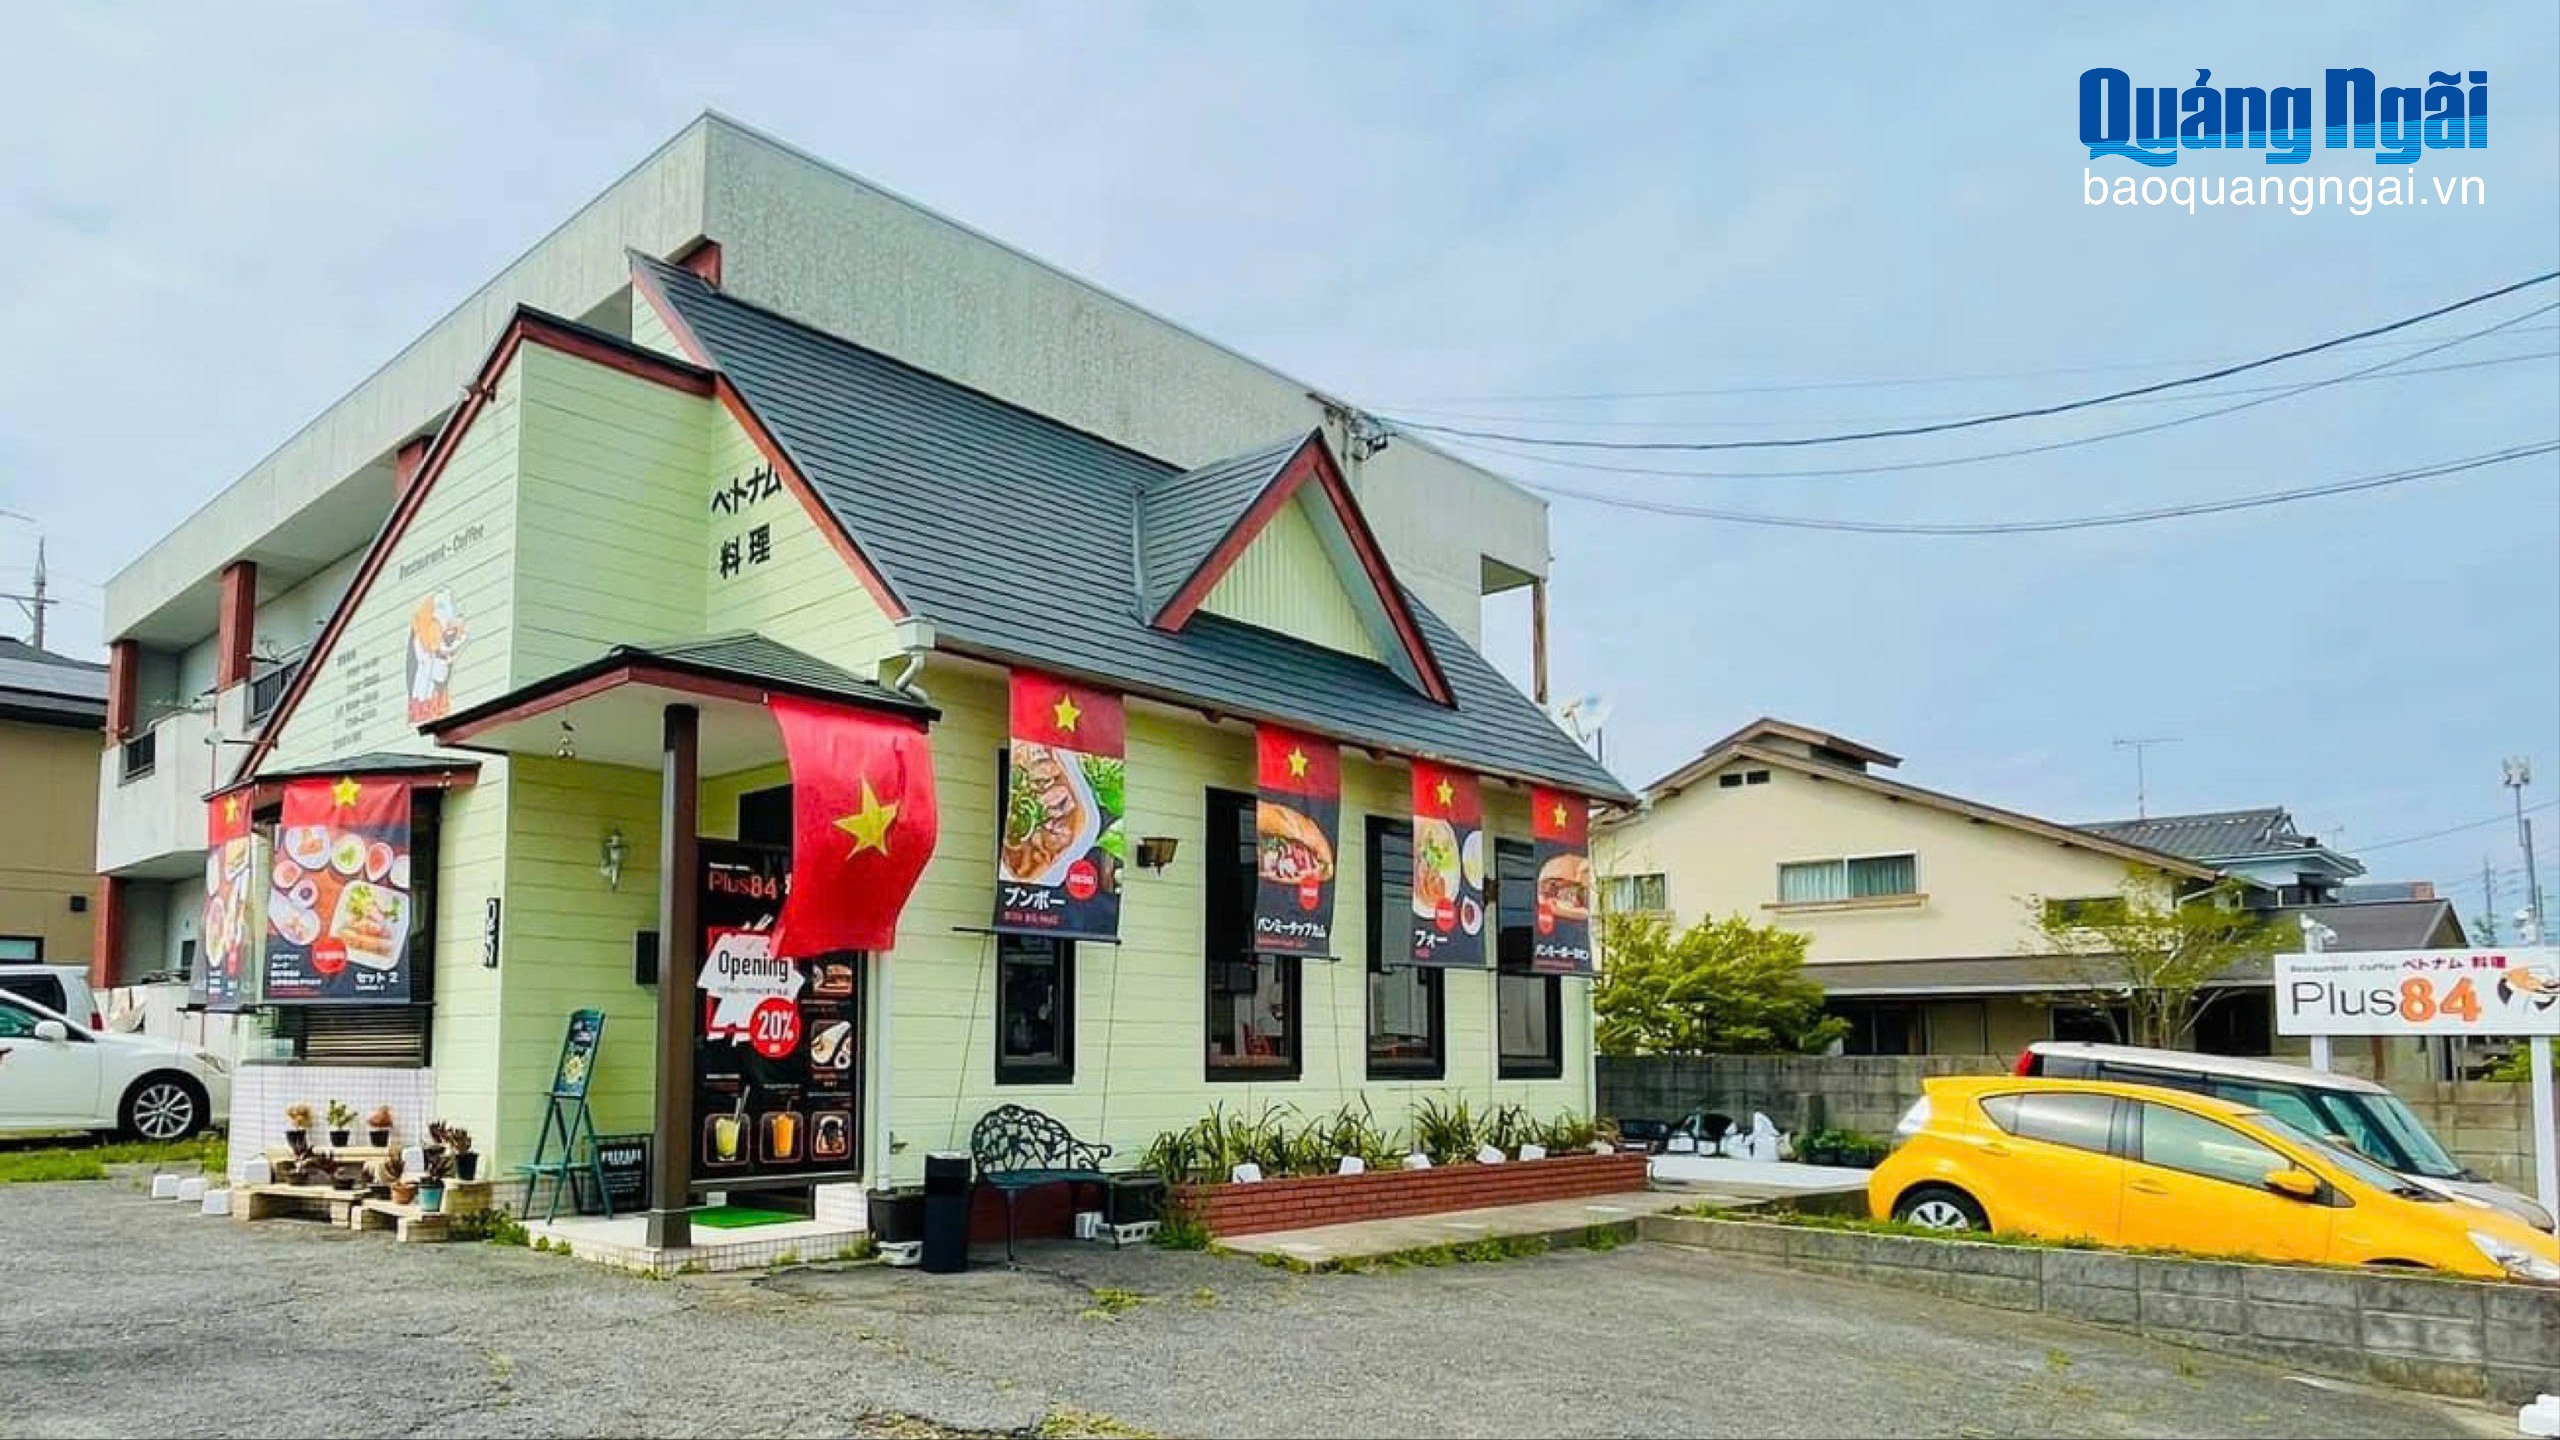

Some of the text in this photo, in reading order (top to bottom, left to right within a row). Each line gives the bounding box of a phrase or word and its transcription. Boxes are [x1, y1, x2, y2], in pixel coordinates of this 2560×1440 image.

[711, 462, 782, 515] ベトナム
[720, 522, 771, 580] 料理
[708, 870, 778, 899] Plus84
[1414, 930, 1448, 949] フォー
[388, 972, 400, 983] 2
[718, 950, 788, 983] Opening
[2402, 957, 2464, 970] ベトナム
[2291, 976, 2482, 1022] Plus84
[757, 1010, 795, 1041] 20%
